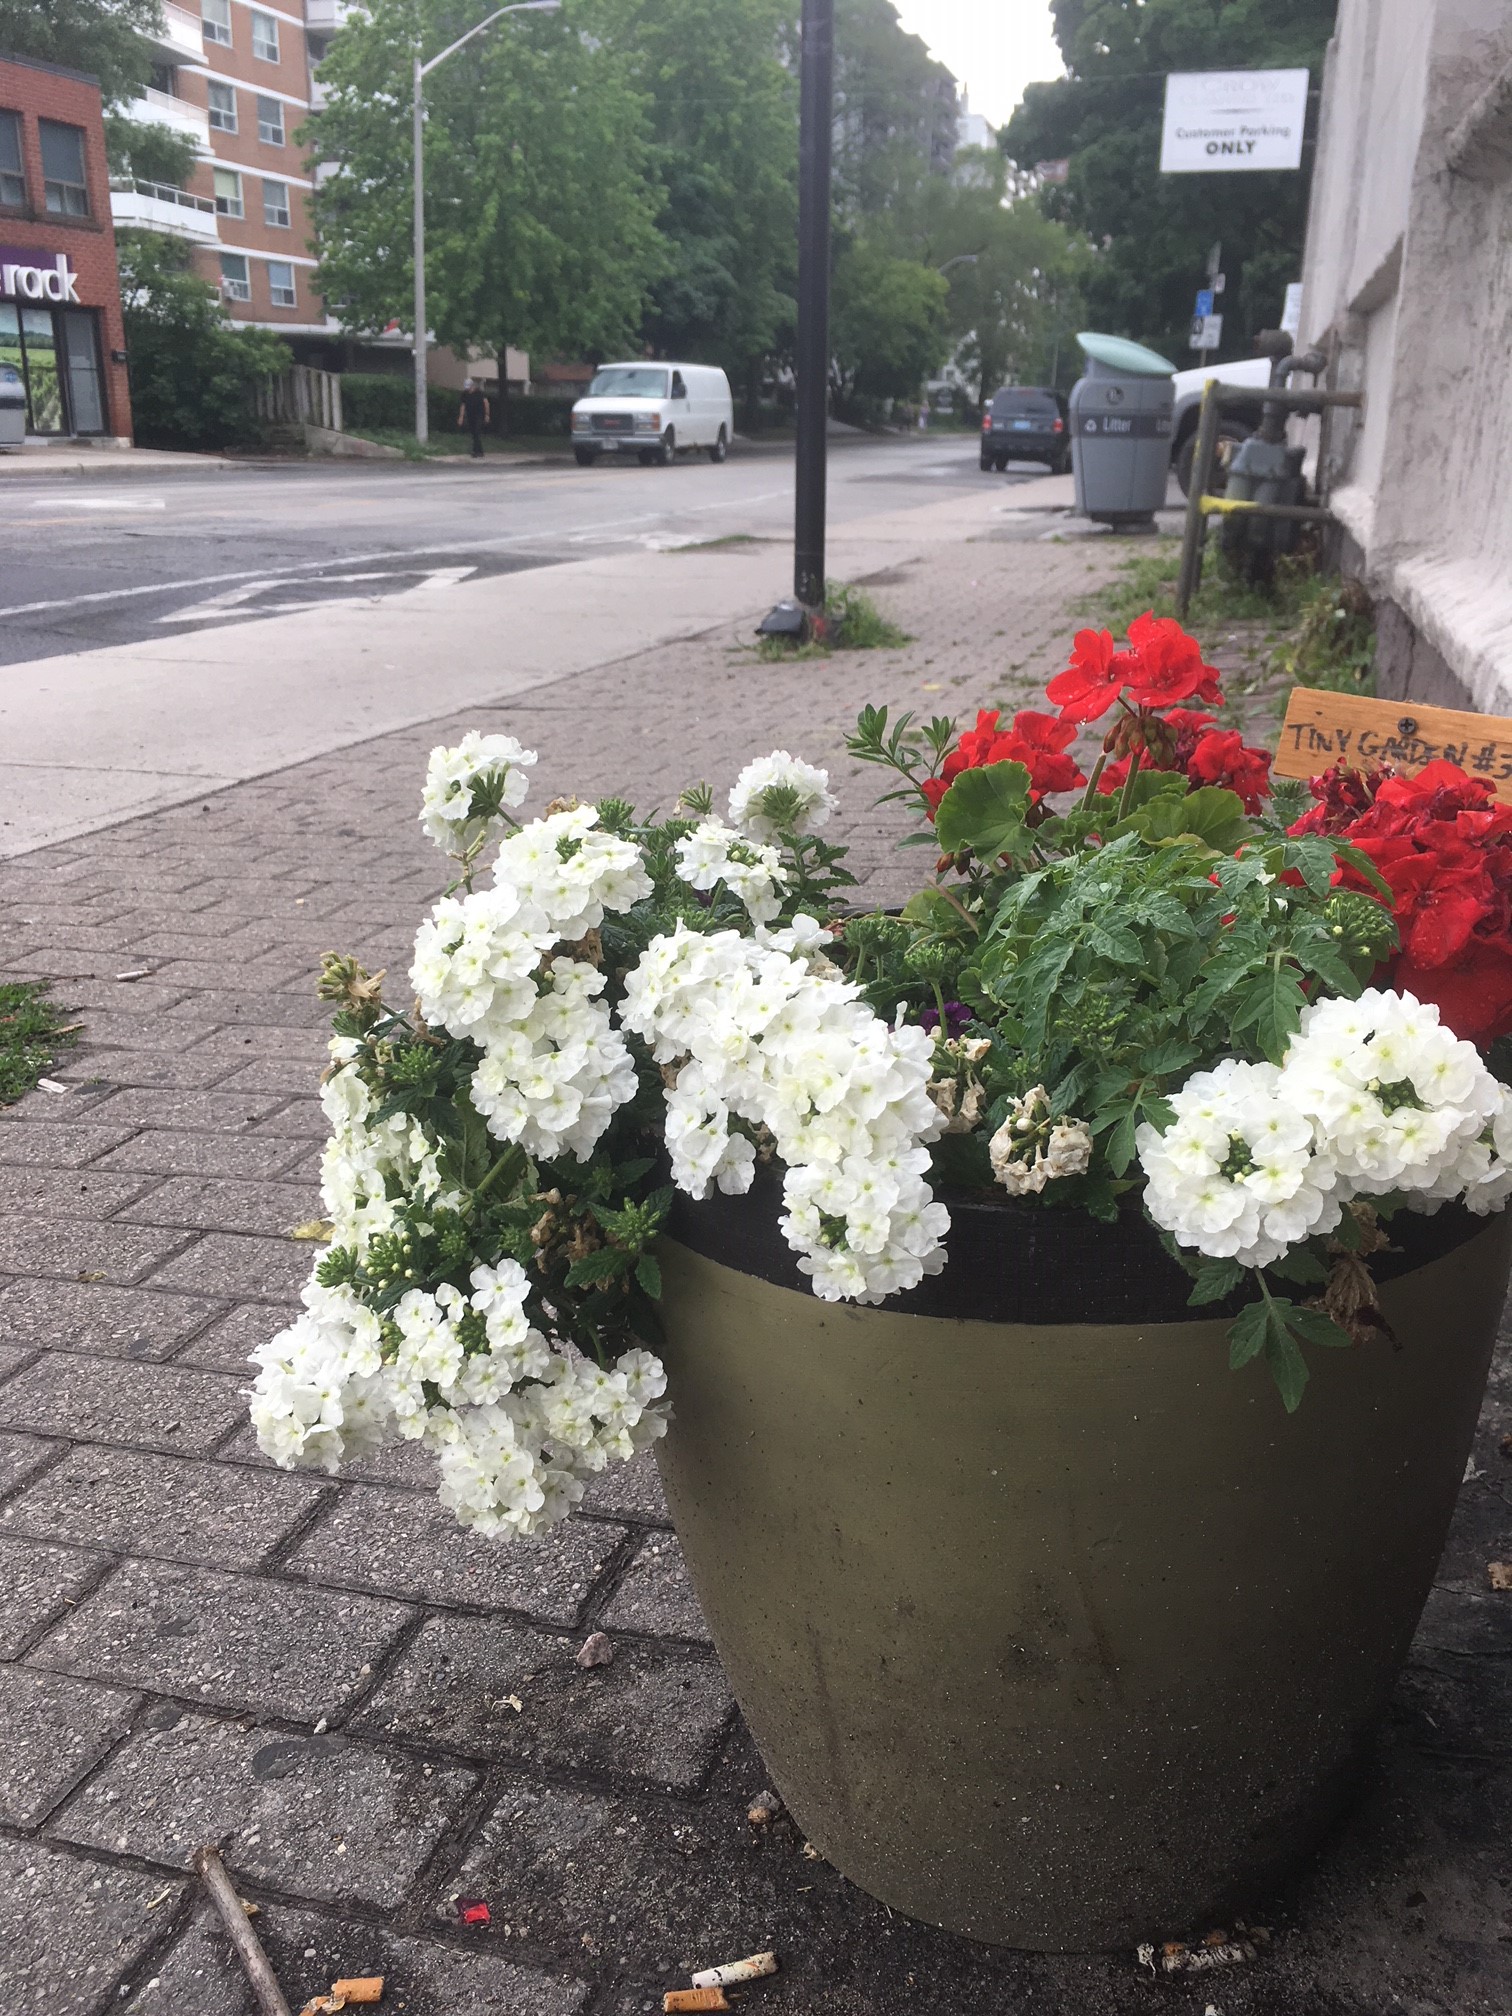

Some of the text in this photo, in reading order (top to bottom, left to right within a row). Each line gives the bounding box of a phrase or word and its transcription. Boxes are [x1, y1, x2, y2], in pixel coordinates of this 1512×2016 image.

[1175, 124, 1291, 141] Customer Parking
[1206, 140, 1256, 155] ONLY
[2, 253, 81, 304] rack
[1102, 416, 1132, 433] Litter
[1287, 722, 1352, 753] TINY
[1357, 730, 1469, 767] GARDEN
